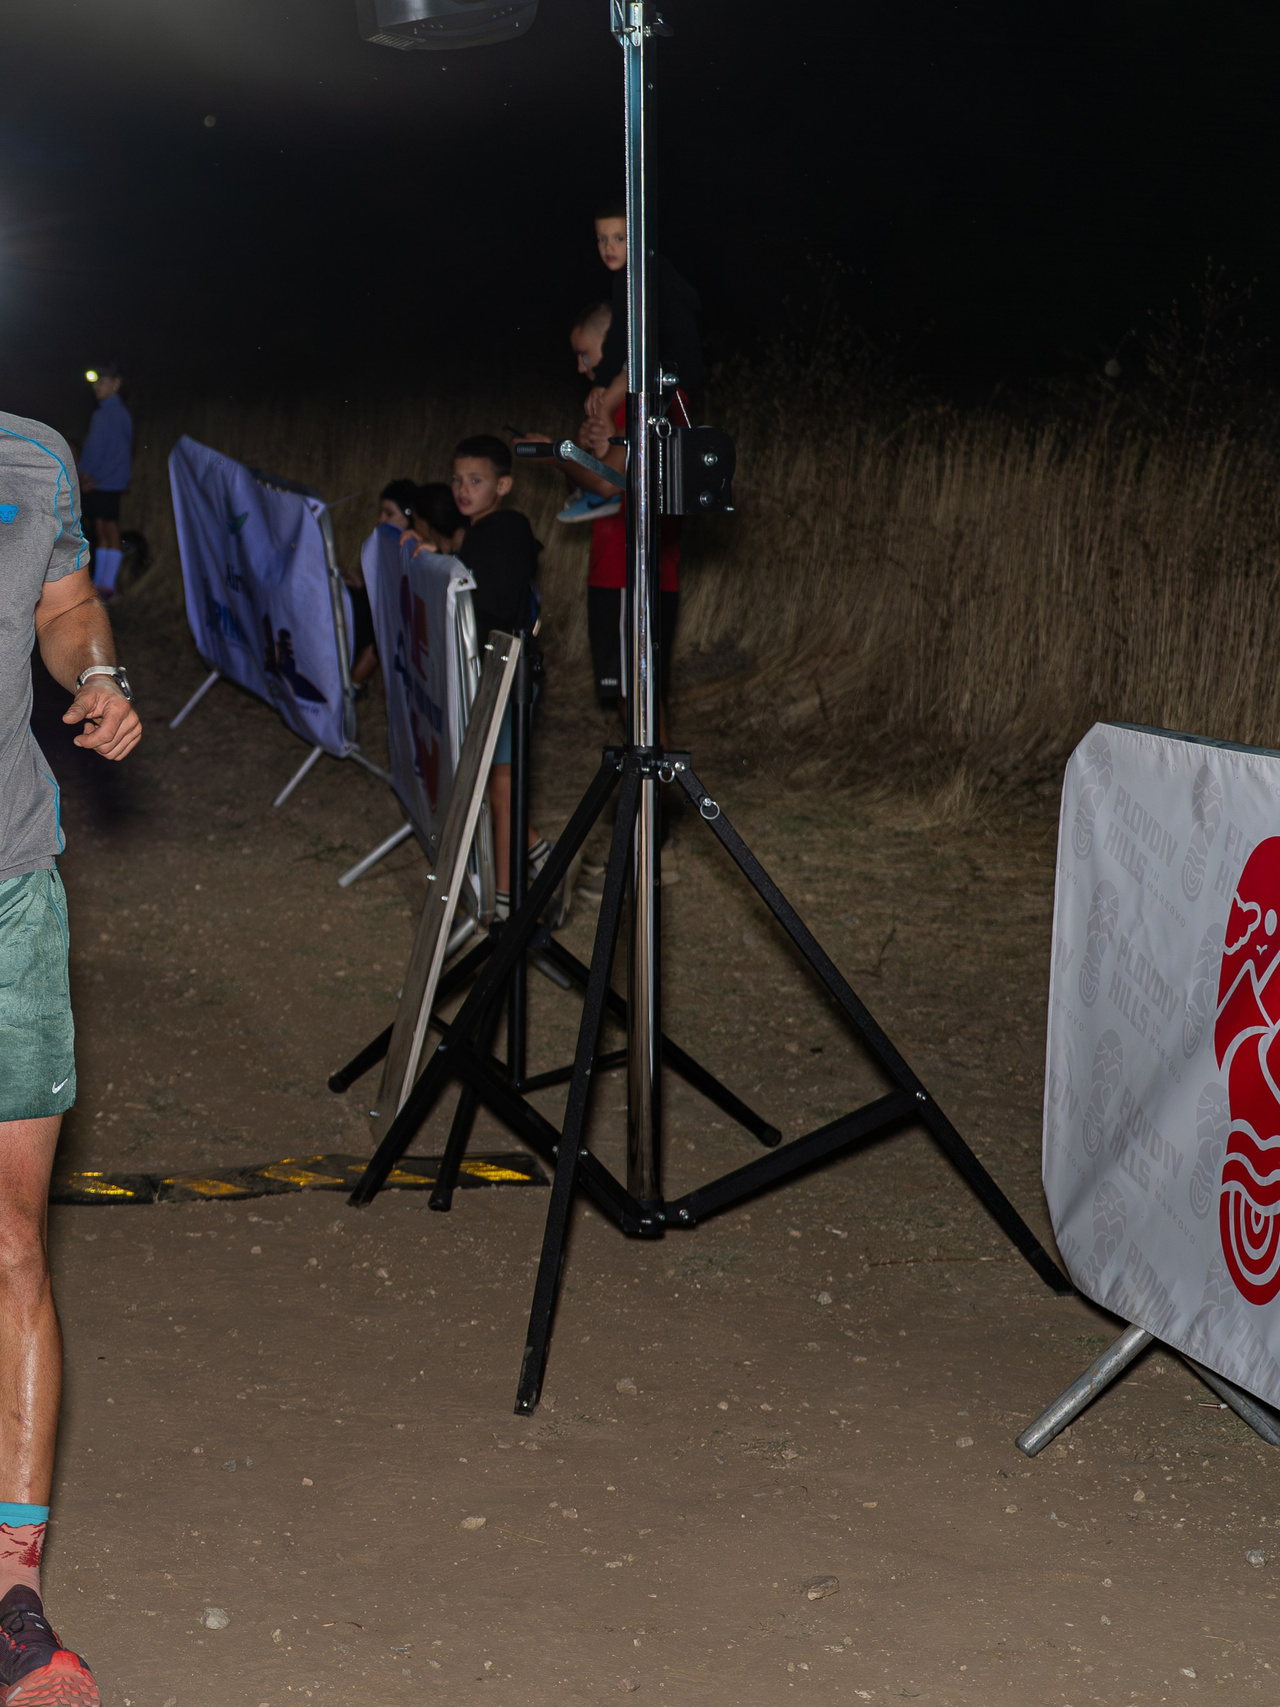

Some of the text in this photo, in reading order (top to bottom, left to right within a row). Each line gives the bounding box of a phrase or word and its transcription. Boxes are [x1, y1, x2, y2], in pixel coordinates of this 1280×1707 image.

[1103, 821, 1148, 885] HILLS
[1113, 784, 1178, 868] PLOVDIV
[1146, 881, 1186, 928] MARKOVO
[1108, 970, 1150, 1037] HILLS
[1154, 1190, 1195, 1244] MARKOVO
